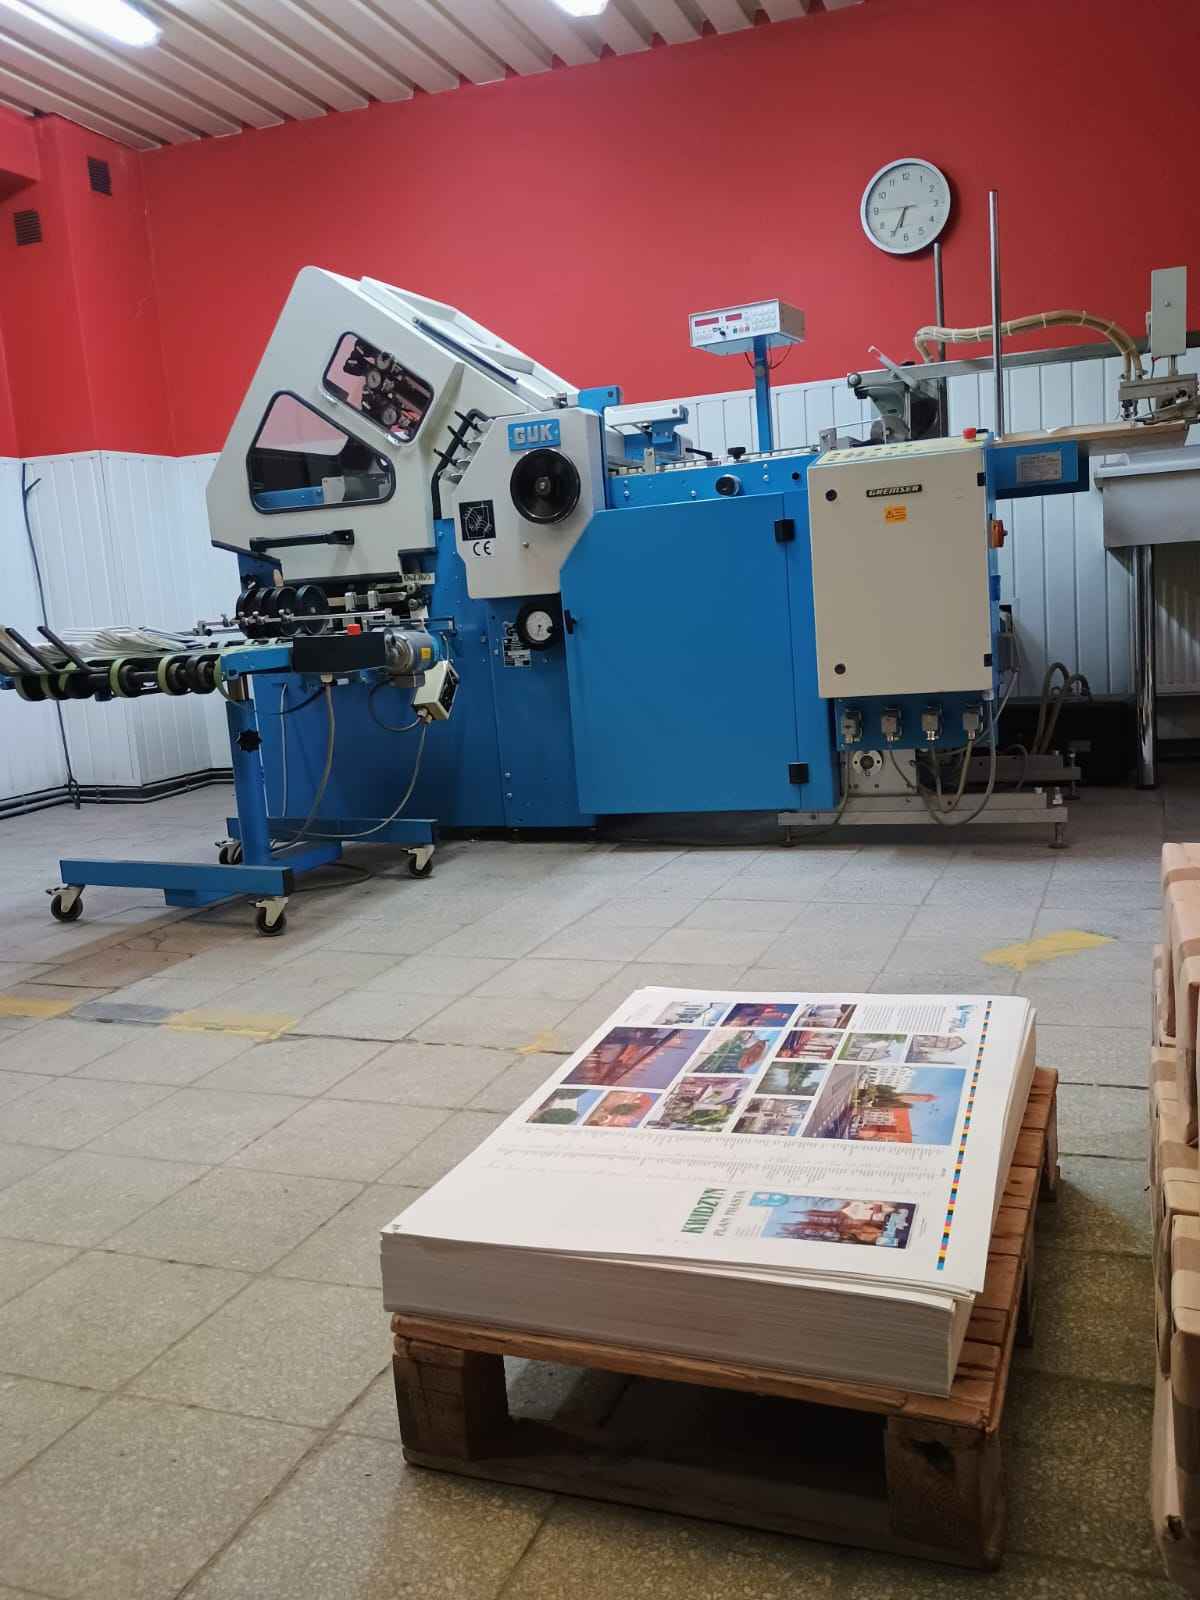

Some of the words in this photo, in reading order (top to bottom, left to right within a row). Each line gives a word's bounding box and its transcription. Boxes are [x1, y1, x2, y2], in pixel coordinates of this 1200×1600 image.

[902, 172, 911, 181] 12
[928, 184, 935, 193] 2
[878, 191, 887, 200] 10
[873, 207, 880, 216] 9
[903, 232, 910, 242] 6
[513, 424, 552, 444] GUK
[473, 541, 491, 556] CE
[680, 1187, 727, 1234] KWIDZYN
[713, 1217, 731, 1237] PLAN
